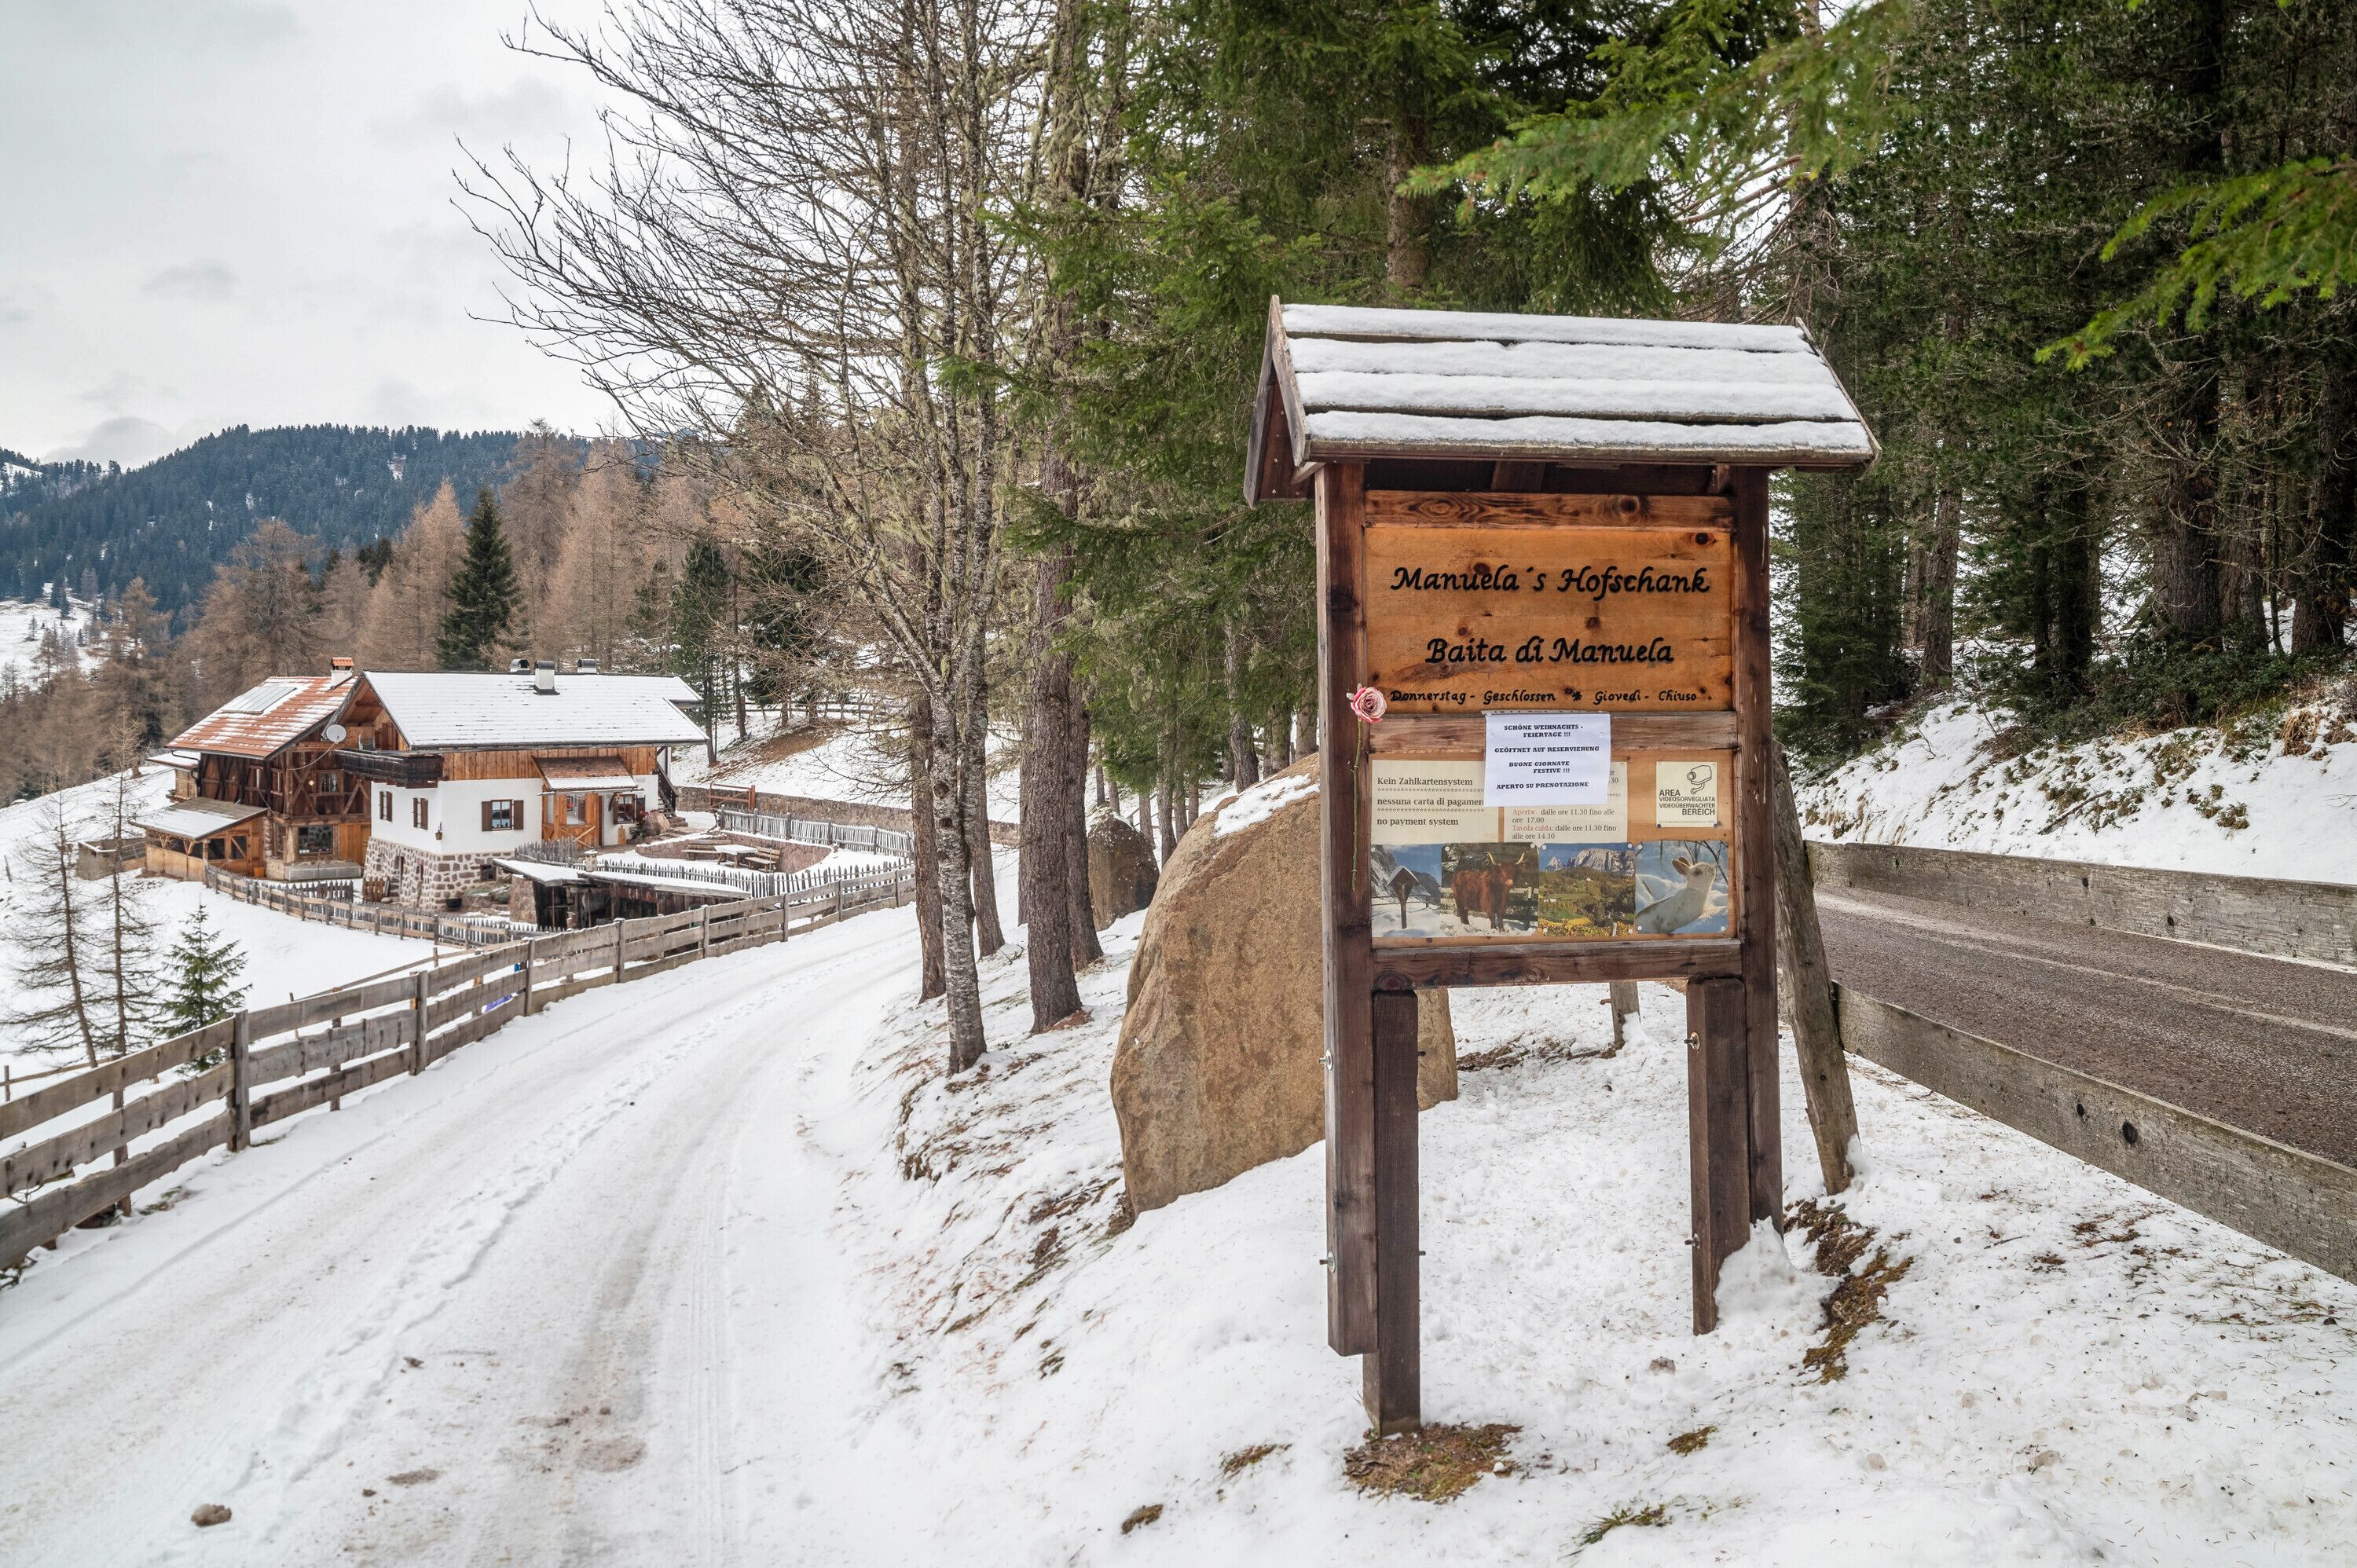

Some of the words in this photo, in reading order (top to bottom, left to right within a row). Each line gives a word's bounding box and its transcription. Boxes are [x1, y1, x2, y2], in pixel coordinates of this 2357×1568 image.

[1556, 566, 1710, 601] Hofschank
[1425, 638, 1506, 663] Baita
[1515, 636, 1544, 663] di
[1549, 637, 1674, 663] Manuela
[1483, 689, 1556, 705] Geschlossen
[1659, 690, 1696, 701] Chiuso
[1399, 778, 1473, 786] Zahlkartensystem
[1390, 818, 1426, 826] payment
